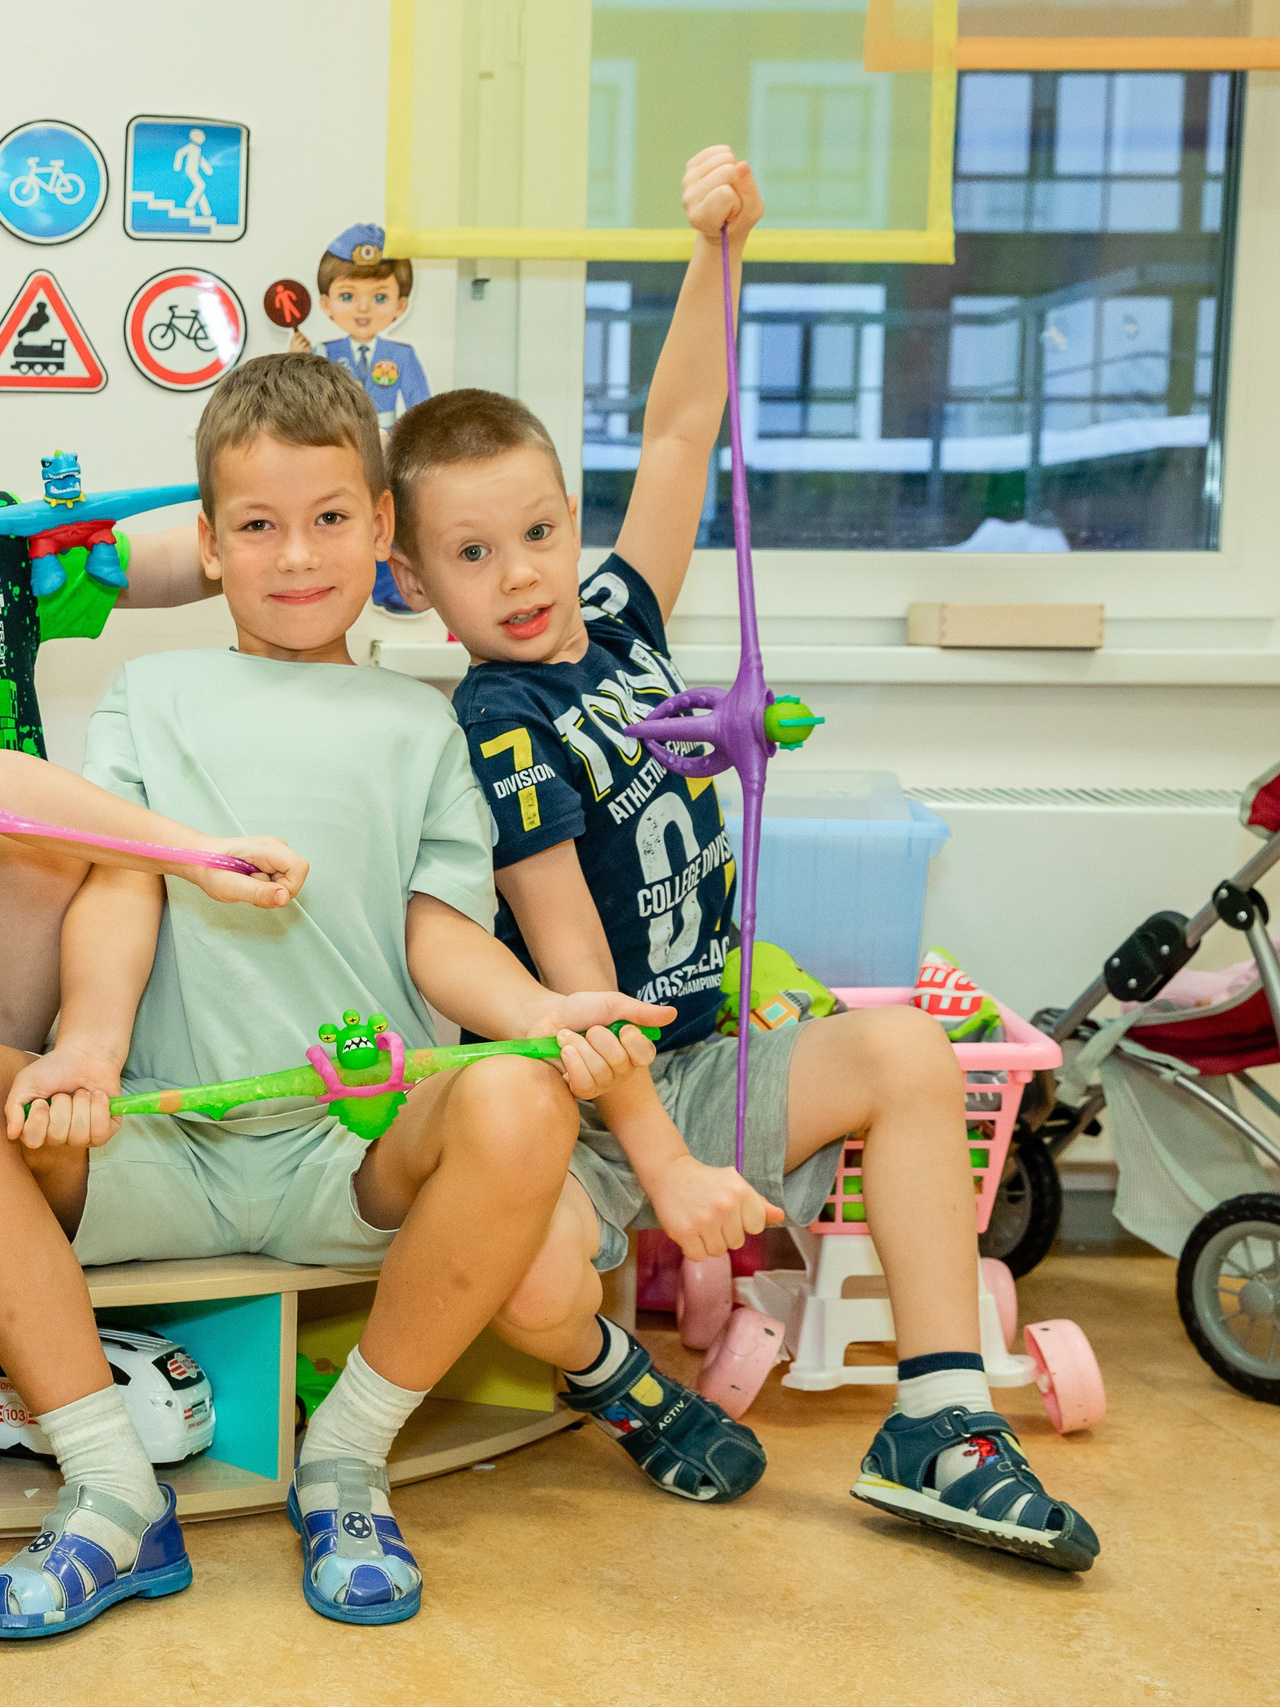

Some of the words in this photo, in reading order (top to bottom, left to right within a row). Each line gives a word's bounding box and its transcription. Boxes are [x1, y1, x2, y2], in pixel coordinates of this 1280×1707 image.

[492, 763, 556, 799] DIVISION
[637, 856, 702, 917] COLLEGE
[701, 831, 732, 879] DIVIS
[5, 1409, 26, 1422] 103
[658, 1400, 686, 1430] ACTIV
